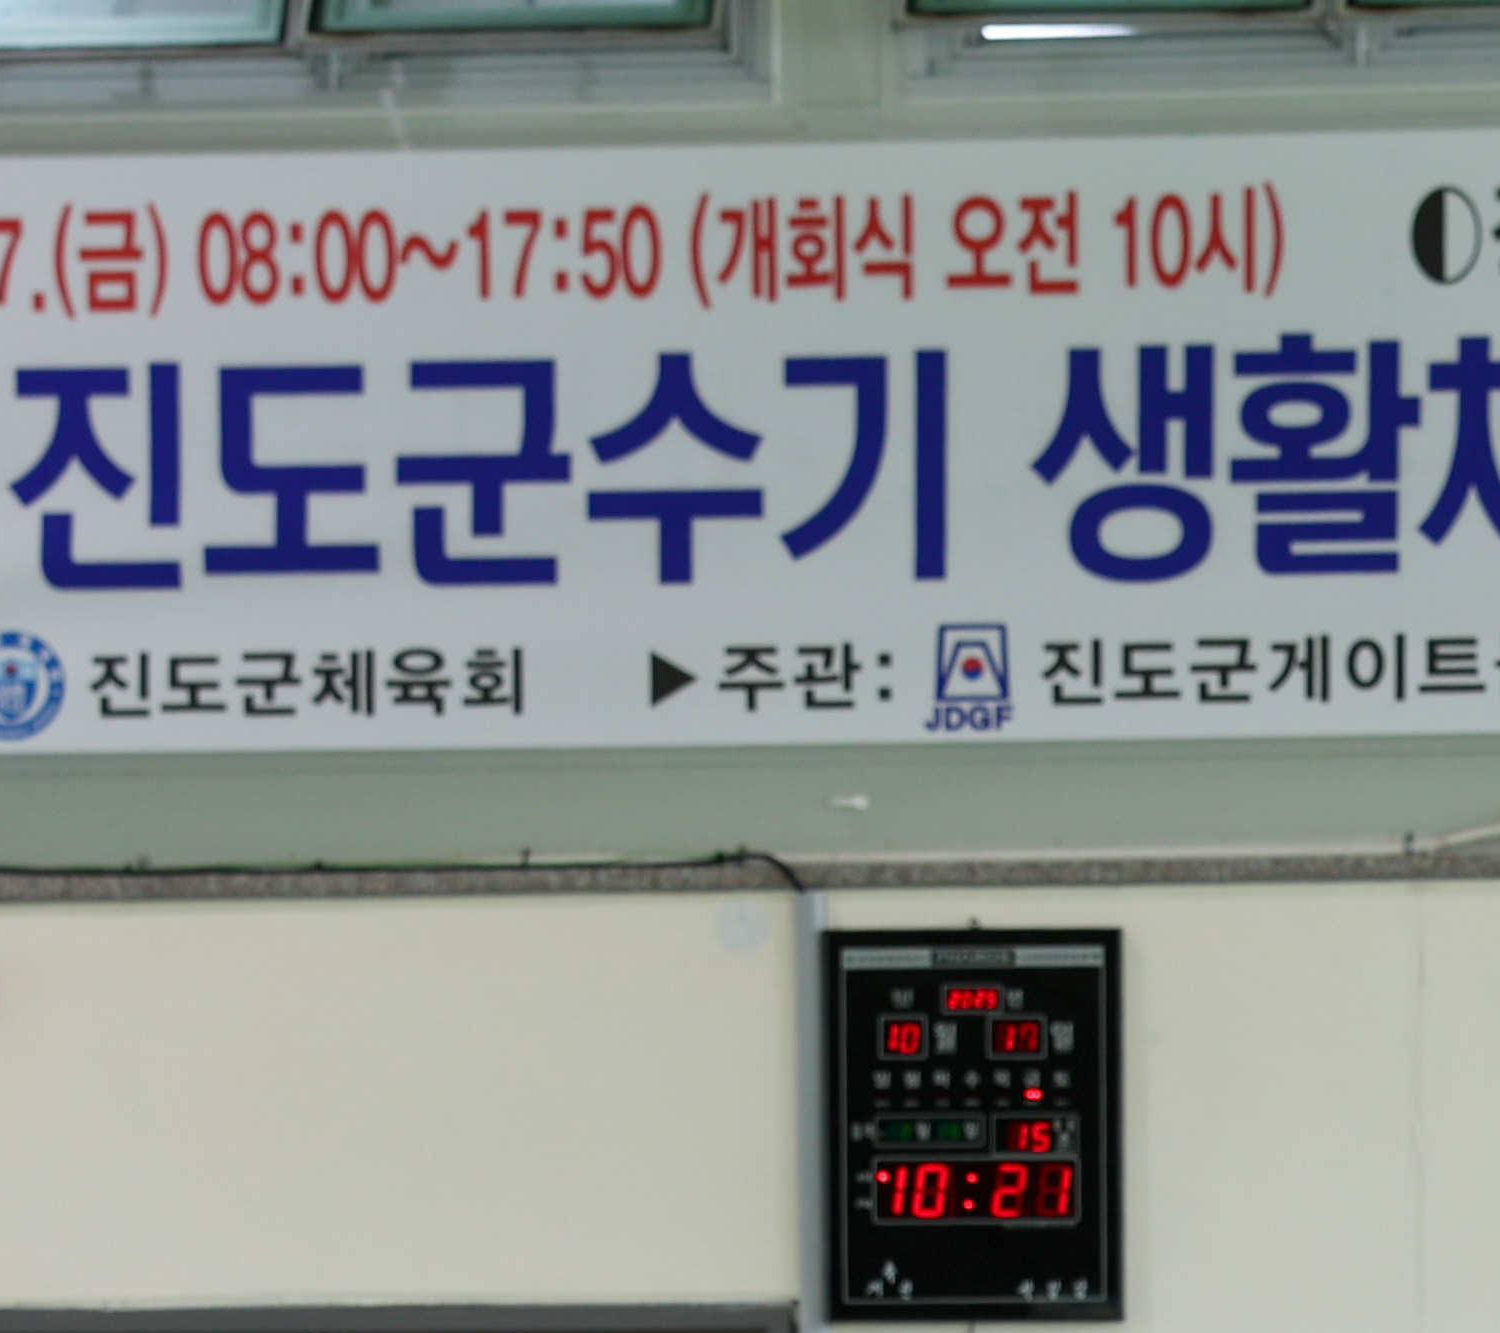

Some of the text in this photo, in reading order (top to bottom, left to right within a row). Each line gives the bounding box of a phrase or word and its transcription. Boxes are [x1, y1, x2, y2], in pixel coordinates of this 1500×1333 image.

[198, 203, 661, 305] 08:00~17:50
[691, 194, 913, 309] (개회식
[947, 191, 1079, 296] 오전
[1114, 182, 1285, 297] 10시)
[9, 350, 948, 590] 진도군수기
[91, 647, 524, 719] 진도군체육회
[718, 643, 892, 712] 주관:
[924, 703, 1013, 732] JDGF
[887, 1021, 921, 1055] 10
[1004, 1021, 1040, 1052] 17
[1017, 1121, 1052, 1153] 15
[891, 1163, 1073, 1219] 10:21
